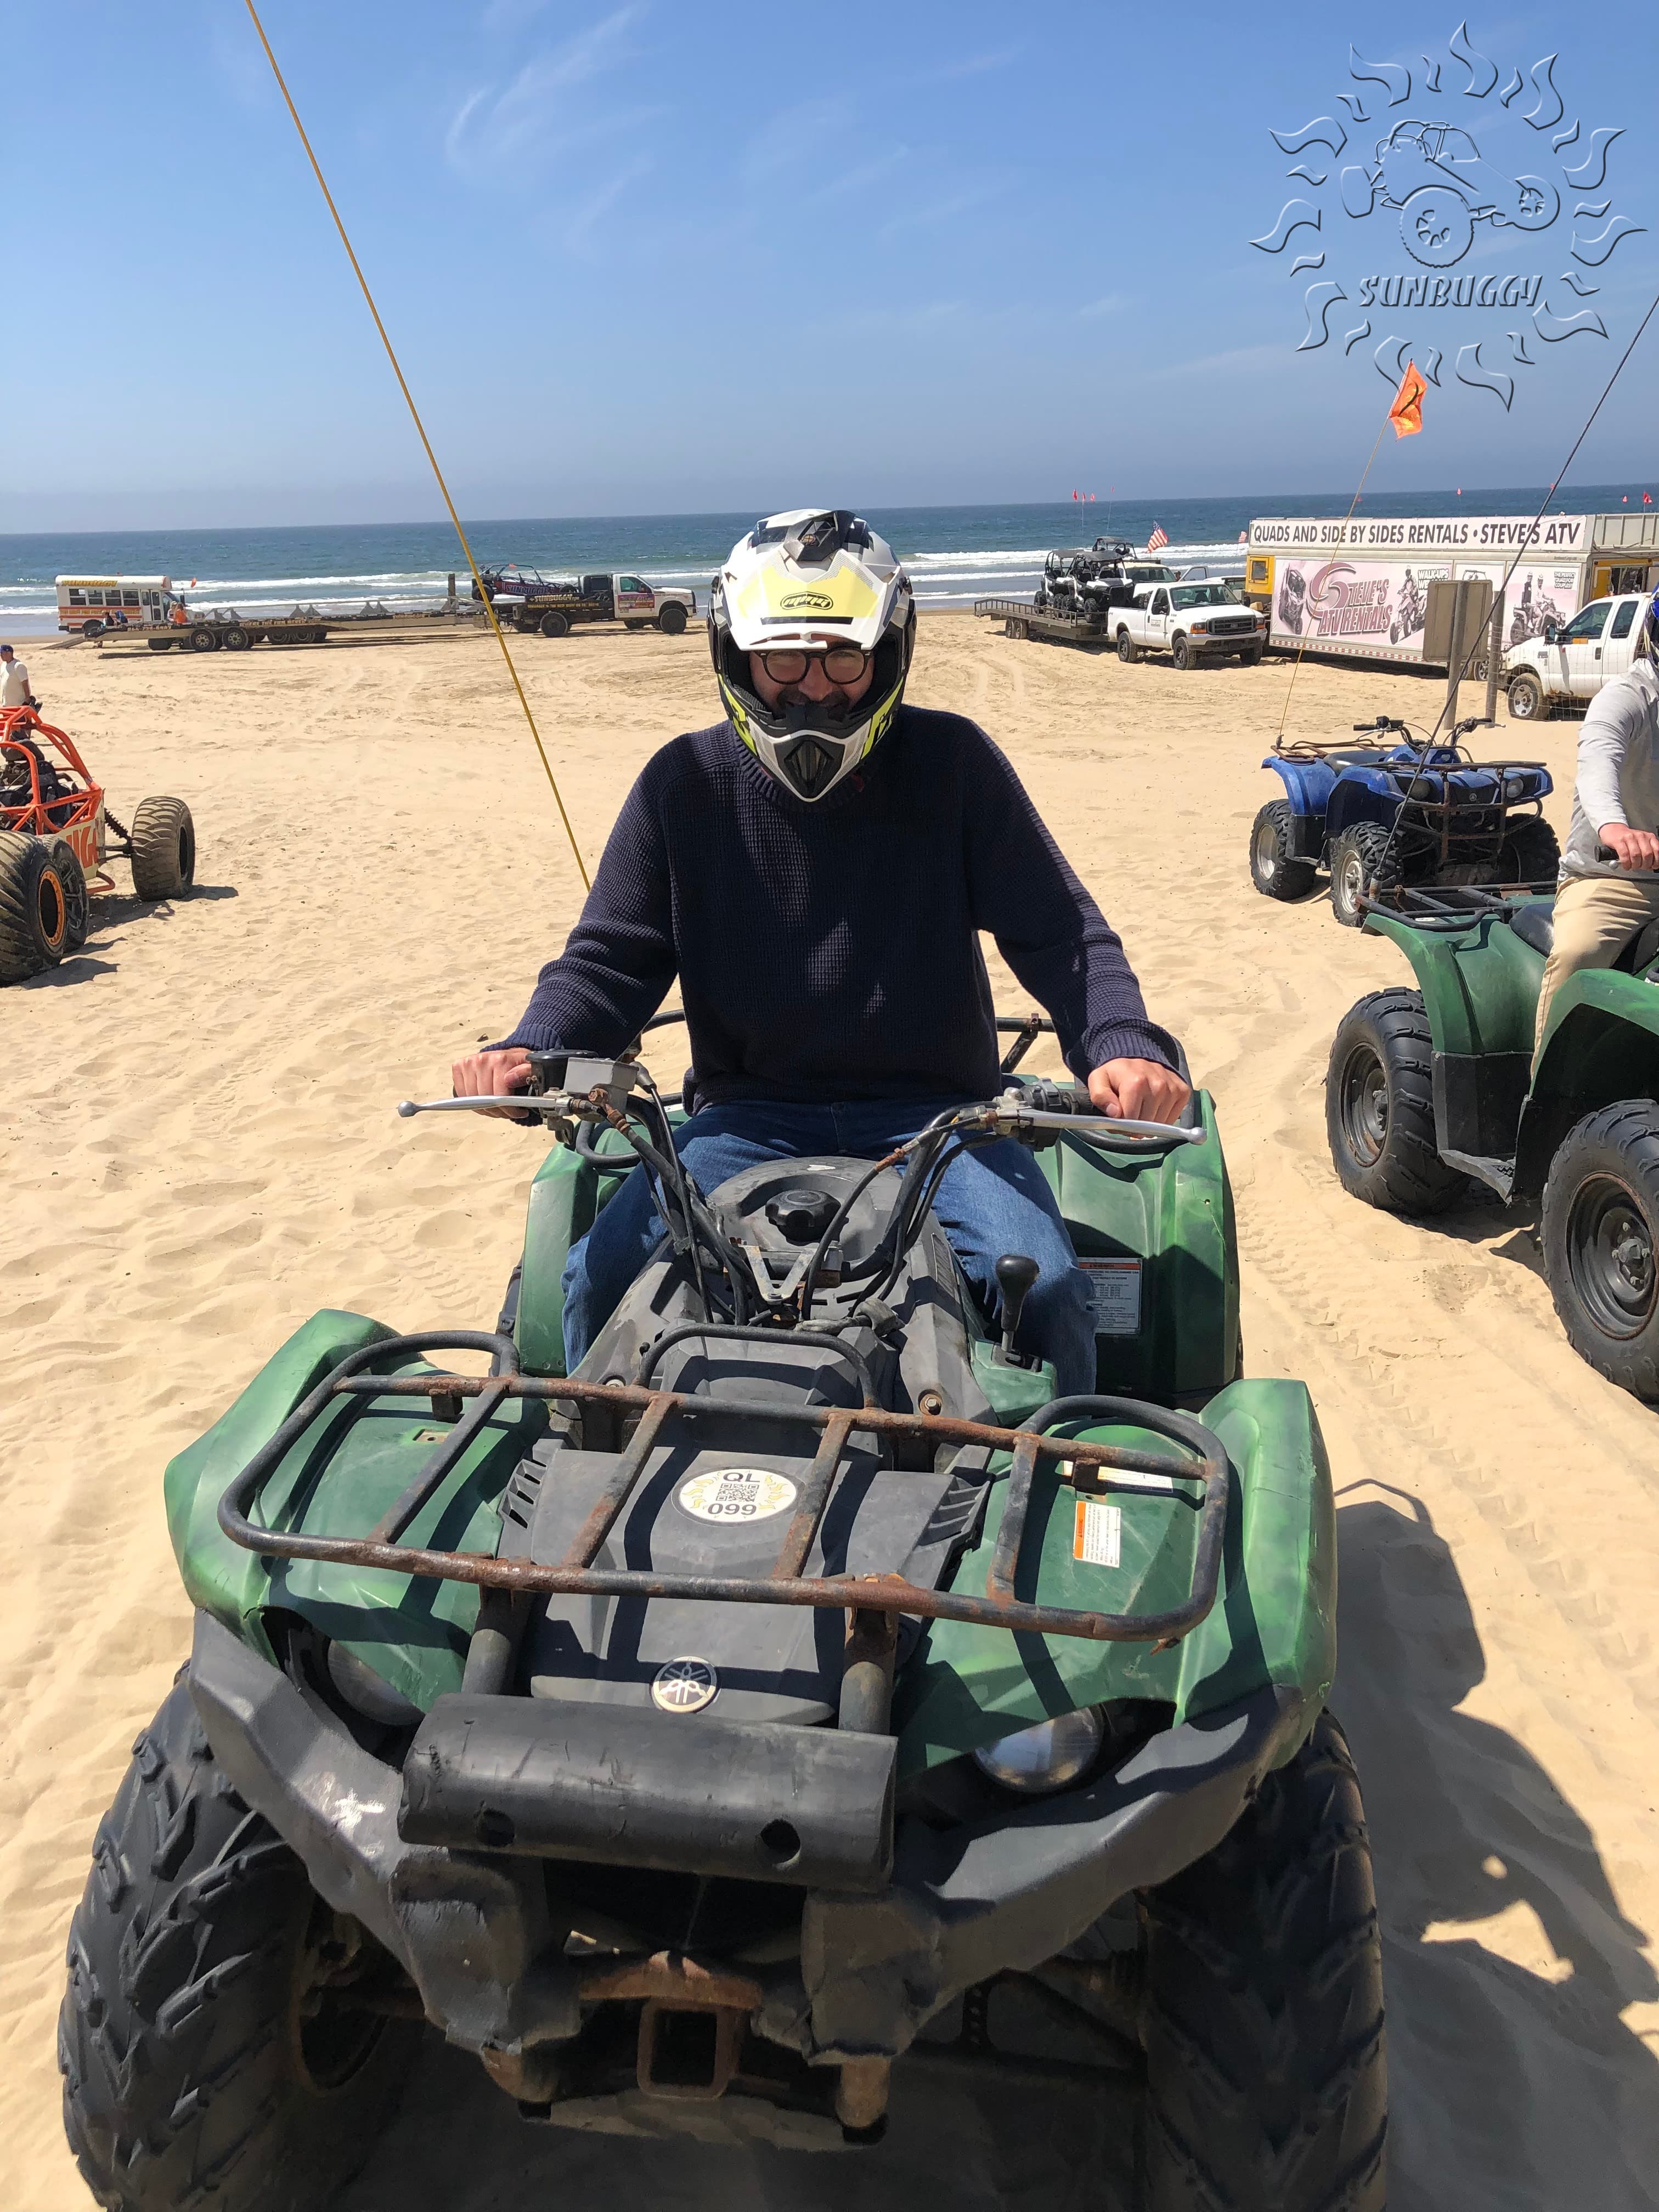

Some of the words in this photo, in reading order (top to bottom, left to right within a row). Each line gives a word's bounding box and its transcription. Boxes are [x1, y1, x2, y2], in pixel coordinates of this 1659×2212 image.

[1254, 525, 1290, 543] QUADS
[1292, 525, 1317, 543] AND
[1321, 525, 1347, 543] SIDE
[1350, 525, 1366, 543] BY
[1368, 524, 1404, 543] SIDES
[1408, 523, 1469, 544] RENTALS
[1480, 523, 1541, 544] STEVE'S
[1544, 523, 1581, 544] ATV
[1317, 608, 1344, 636] ATV
[1340, 604, 1393, 634] RENTALS
[723, 1472, 760, 1482] QL
[708, 1503, 757, 1515] 099
